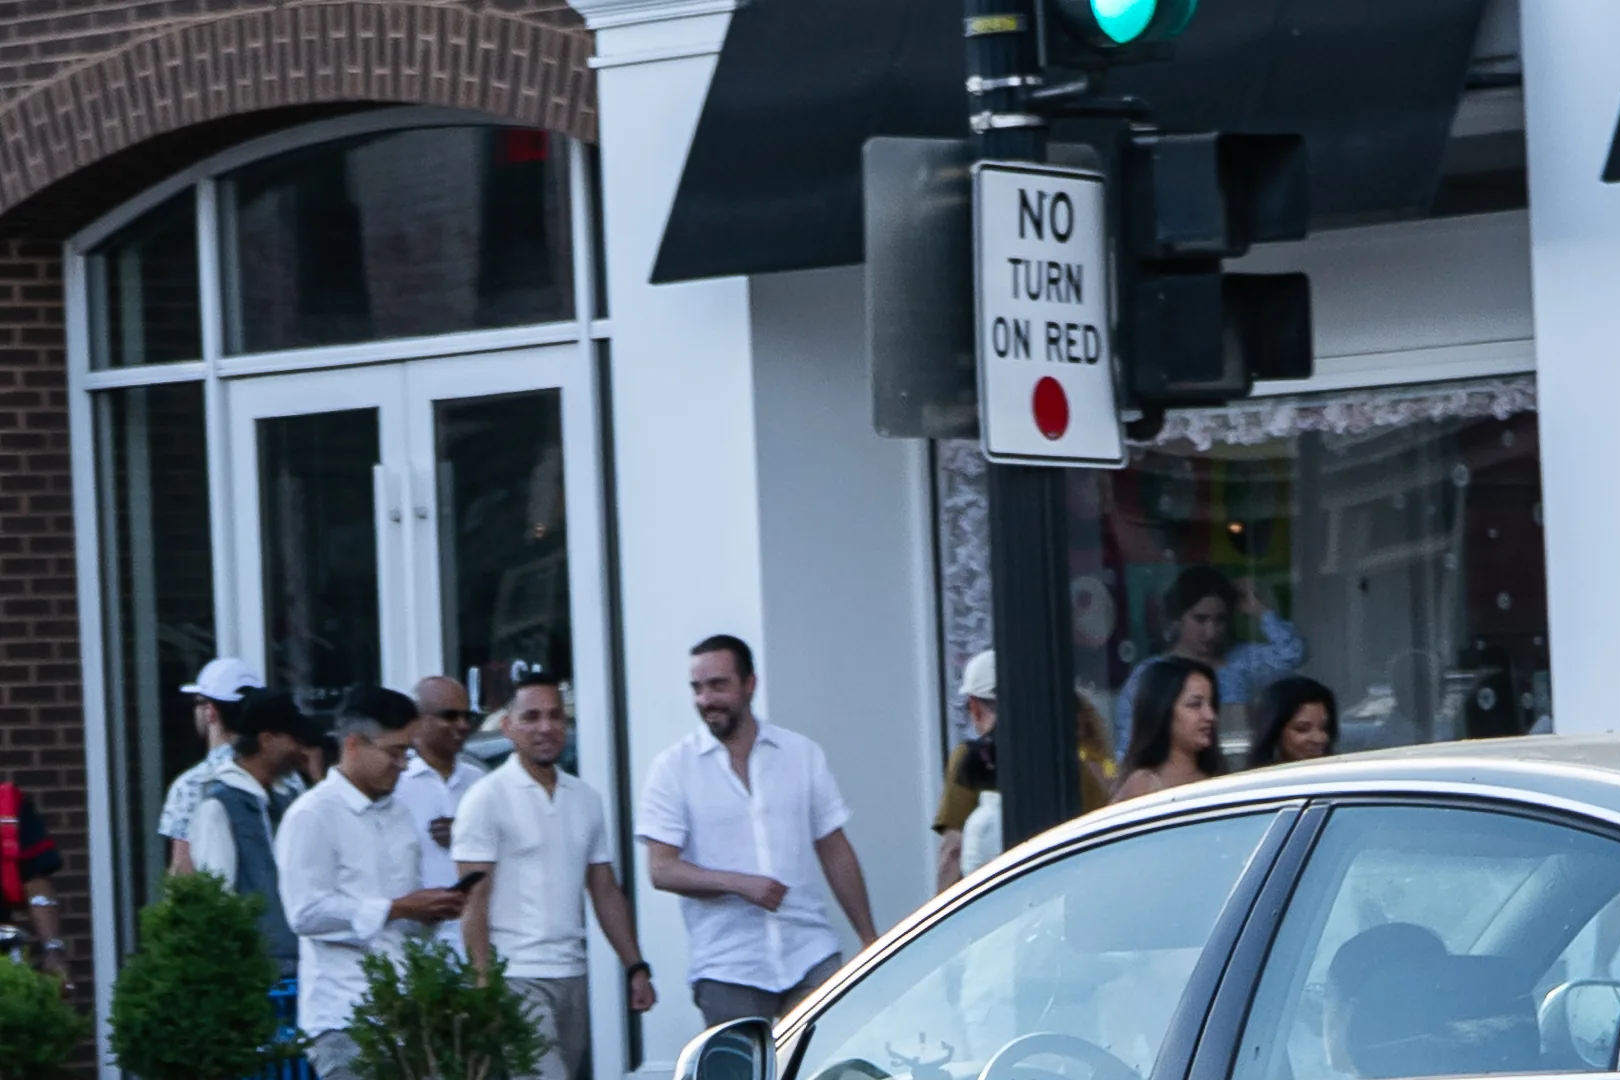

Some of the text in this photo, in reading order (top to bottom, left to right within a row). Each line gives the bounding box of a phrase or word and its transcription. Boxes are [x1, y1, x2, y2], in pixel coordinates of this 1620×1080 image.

[1018, 188, 1075, 244] NO
[1007, 257, 1084, 304] TURN
[992, 316, 1101, 365] ON RED
